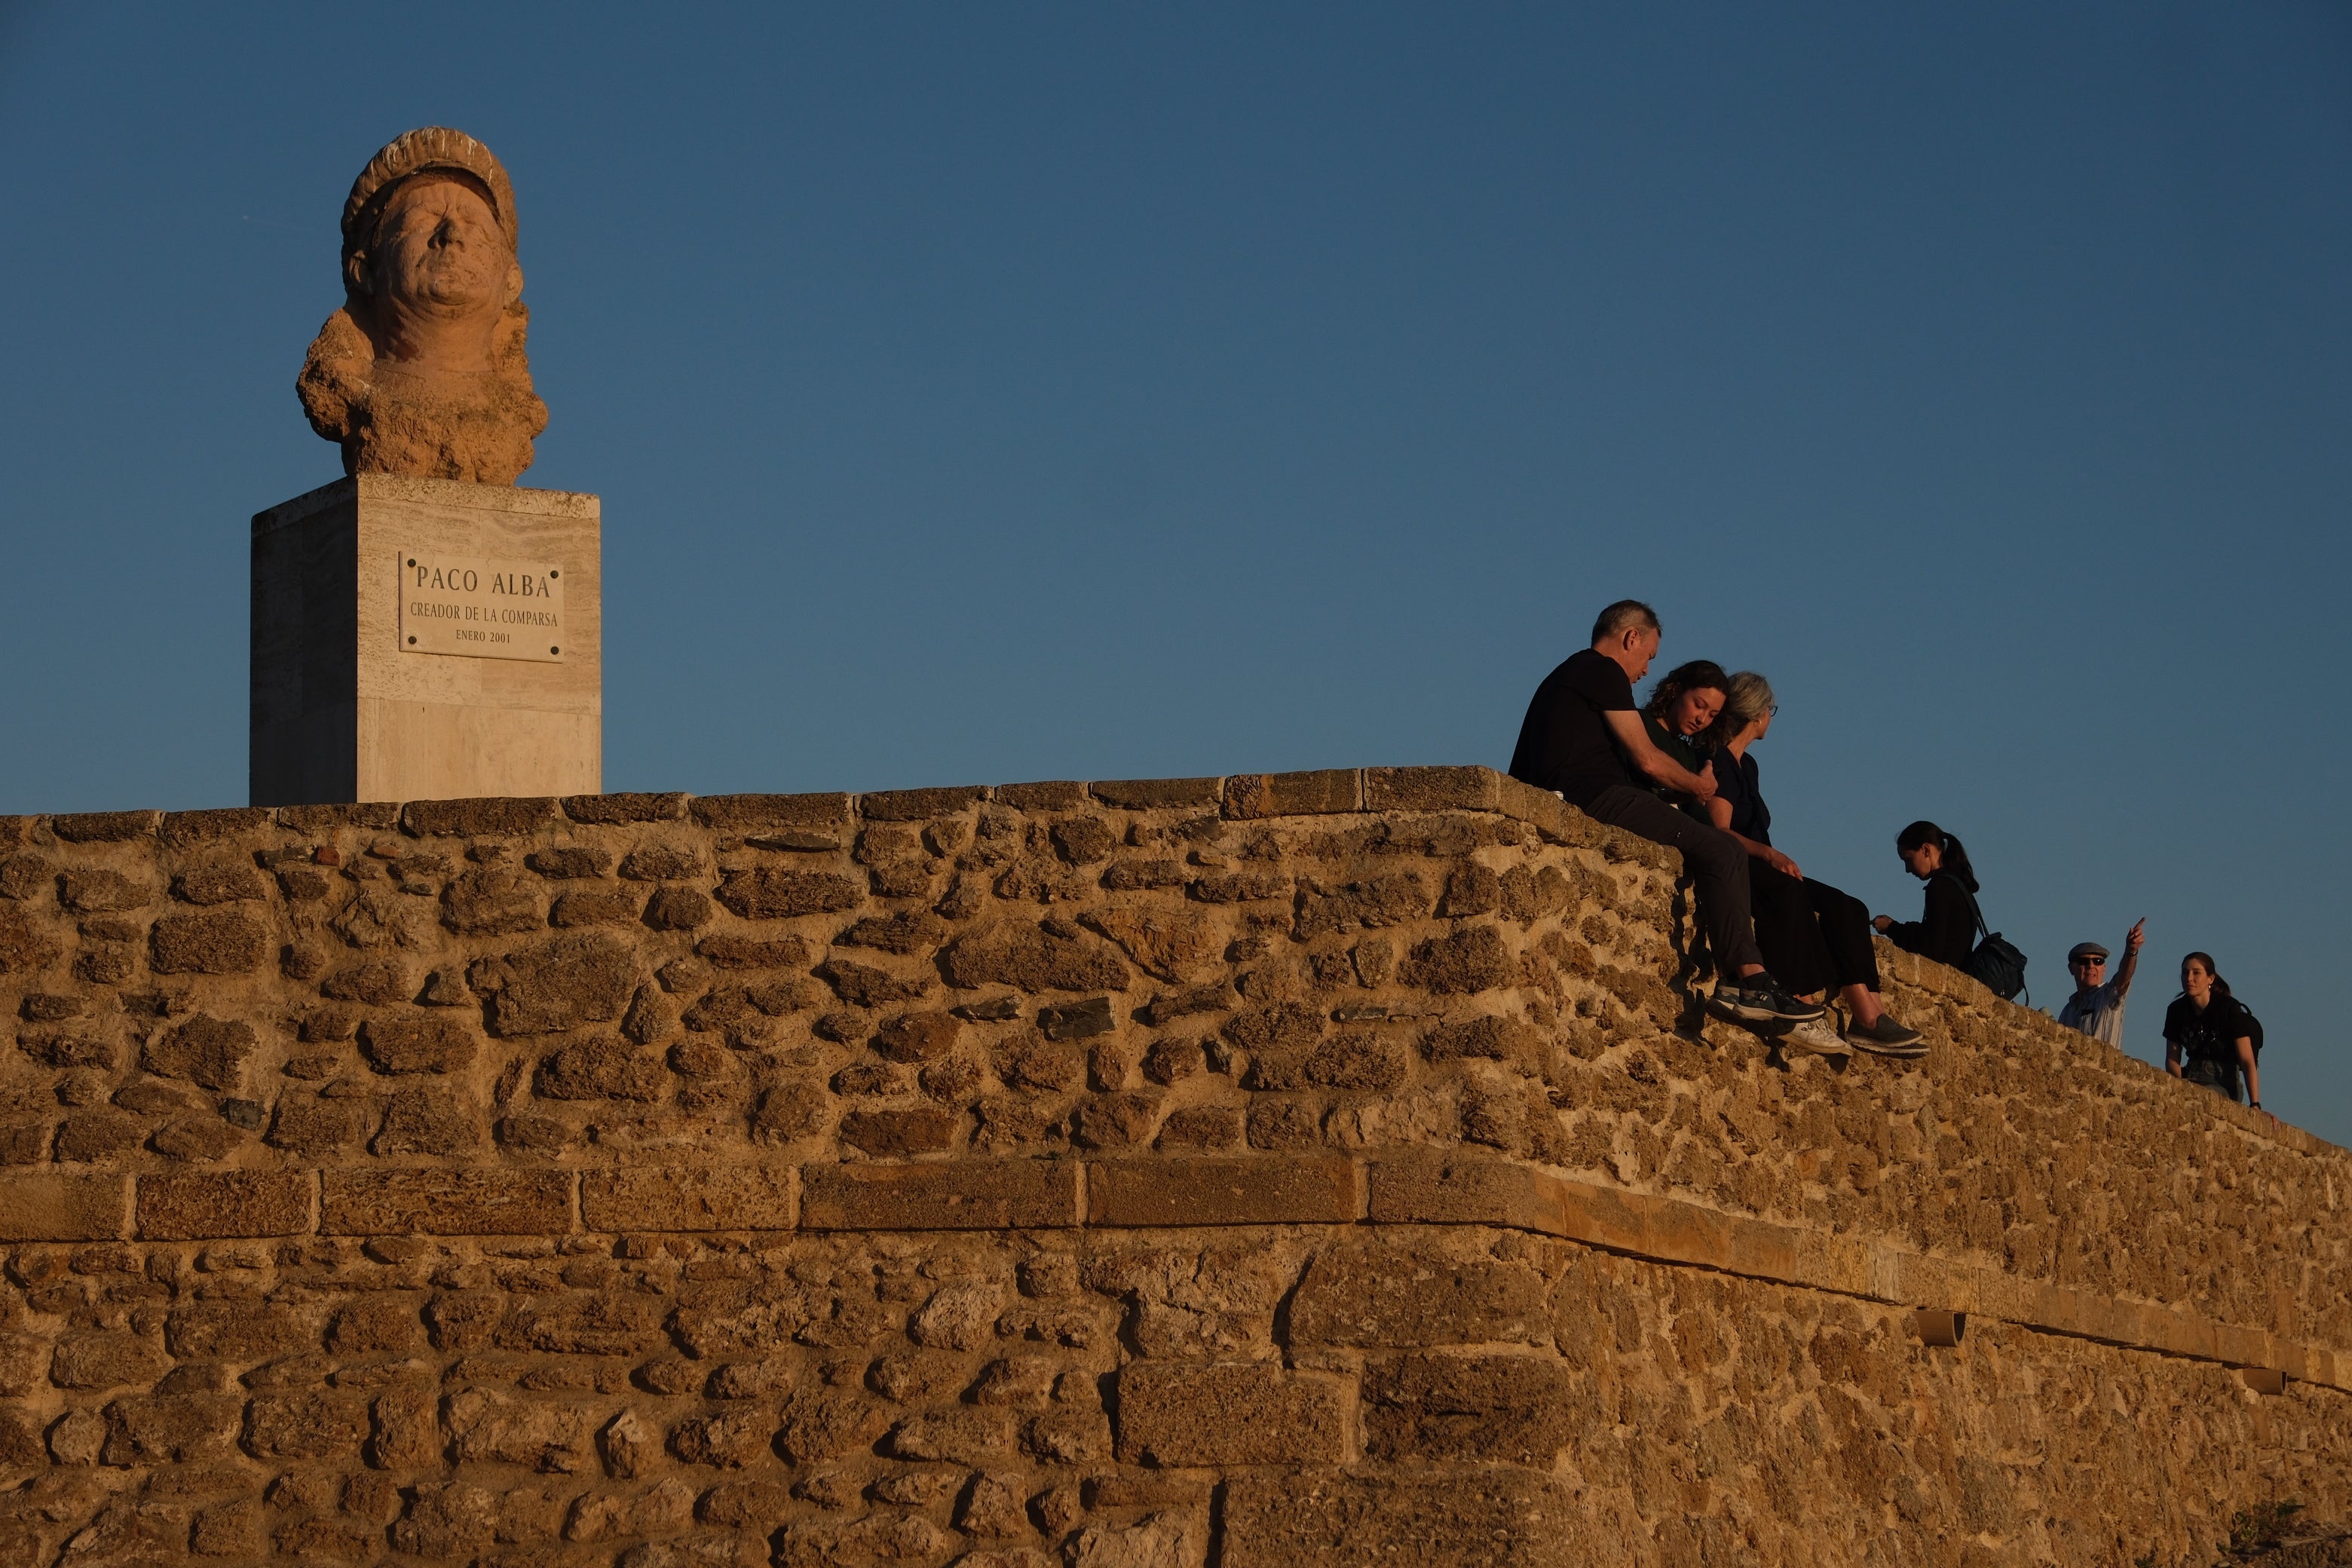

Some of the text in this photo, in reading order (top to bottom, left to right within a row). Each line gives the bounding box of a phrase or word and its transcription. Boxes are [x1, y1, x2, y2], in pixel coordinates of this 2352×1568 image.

[417, 566, 550, 598] PACO ALBA
[410, 602, 558, 627] CREADOR DE LA COMPARSA
[456, 629, 510, 644] ENERO 2001
